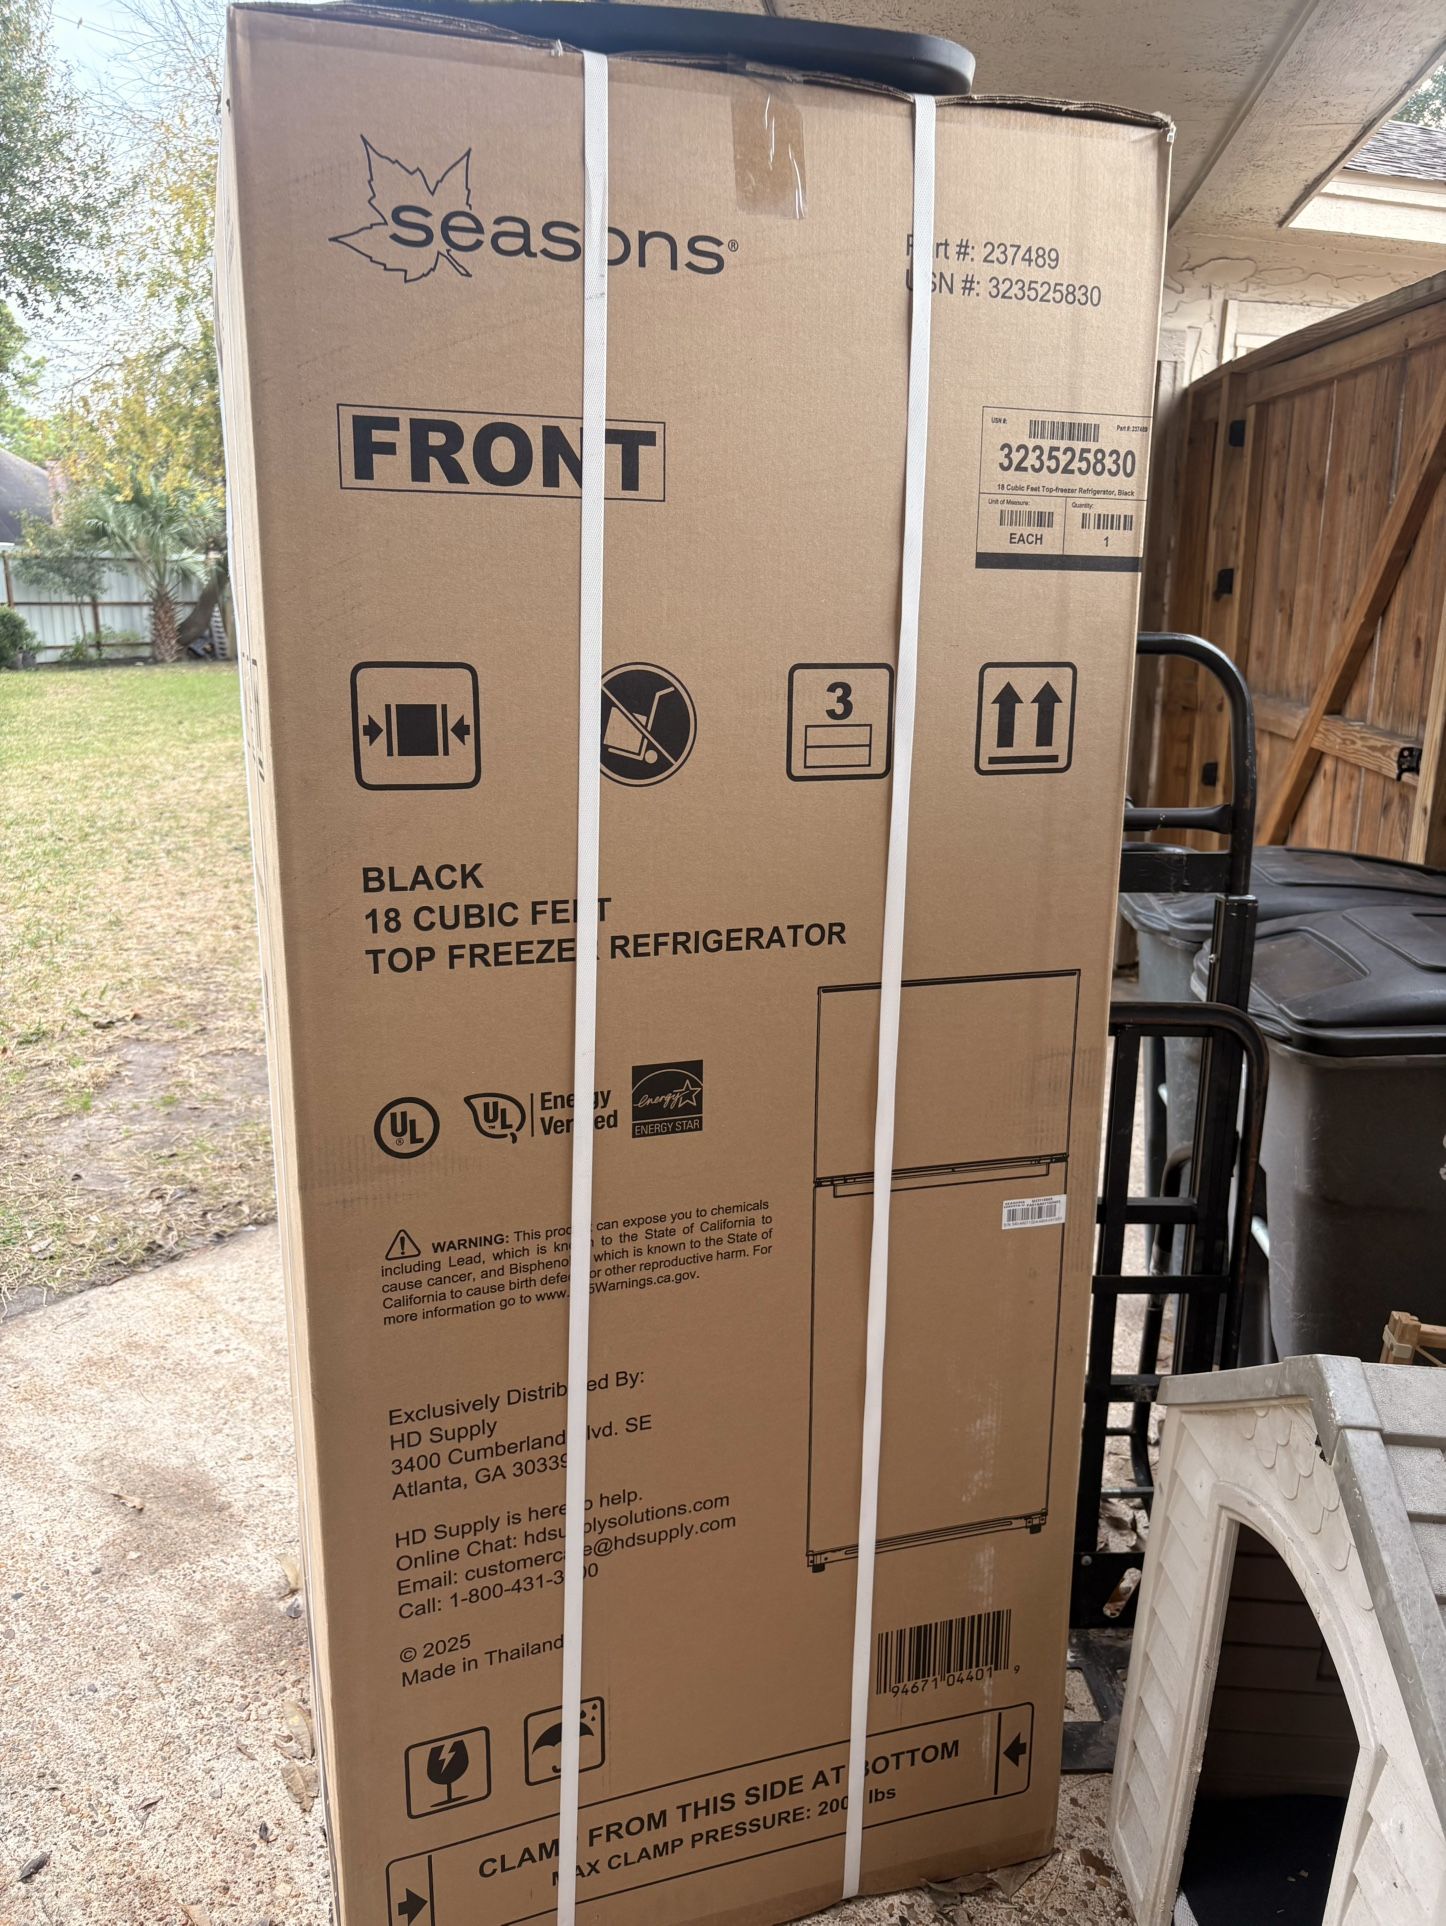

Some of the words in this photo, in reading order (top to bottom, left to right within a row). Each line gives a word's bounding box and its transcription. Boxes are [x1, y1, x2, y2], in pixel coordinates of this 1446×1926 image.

[956, 238, 975, 262] #:
[982, 241, 1060, 270] 237489
[961, 274, 980, 297] #:
[988, 276, 1101, 307] 323525830
[352, 415, 657, 491] FRONT
[999, 443, 1136, 478] 323525830
[1006, 484, 1025, 492] Cubic
[1042, 485, 1077, 494] Top-freezer
[1079, 487, 1117, 497] Refrigerator,
[1118, 489, 1135, 497] Black
[1009, 533, 1043, 545] EACH
[1103, 536, 1109, 547] 1
[826, 682, 853, 720] 3
[362, 863, 484, 893] BLACK
[365, 907, 402, 934] 18
[413, 901, 519, 932] CUBIC
[531, 898, 612, 926] FET
[365, 946, 436, 974] TOP
[448, 938, 599, 970] FREEZE
[610, 922, 846, 959] REFRIGERATOR
[483, 1101, 513, 1129] UL
[633, 1090, 686, 1110] energy
[390, 1111, 424, 1144] UL
[634, 1122, 674, 1136] ENERGY
[675, 1119, 700, 1132] STAR
[432, 1233, 510, 1253] WARNING:
[513, 1229, 541, 1243] This
[596, 1220, 619, 1231] can
[622, 1214, 667, 1230] expose
[670, 1211, 692, 1225] you
[696, 1207, 708, 1218] to
[710, 1200, 769, 1216] chemicals
[381, 1259, 442, 1277] including
[449, 1252, 486, 1268] Lead,
[492, 1246, 530, 1261] which
[536, 1243, 547, 1256] is
[601, 1236, 613, 1246] to
[619, 1231, 638, 1244] the
[645, 1227, 676, 1240] State
[682, 1223, 695, 1235] of
[700, 1217, 756, 1233] California
[761, 1215, 773, 1225] to
[382, 1279, 423, 1293] cause
[427, 1273, 476, 1288] cancer,
[480, 1266, 505, 1279] and
[593, 1246, 629, 1262] which
[633, 1244, 643, 1257] is
[647, 1240, 686, 1255] known
[690, 1238, 701, 1249] to
[705, 1234, 723, 1247] the
[727, 1231, 757, 1244] State
[761, 1227, 774, 1240] of
[383, 1289, 447, 1309] California
[450, 1288, 463, 1299] to
[466, 1283, 505, 1297] cause
[508, 1276, 537, 1291] birth
[589, 1267, 602, 1279] or
[604, 1263, 636, 1277] other
[639, 1252, 713, 1273] reproductive
[716, 1248, 750, 1261] harm.
[753, 1243, 773, 1256] For
[383, 1312, 418, 1325] more
[422, 1301, 496, 1320] information
[500, 1298, 515, 1311] go
[520, 1293, 532, 1305] to
[389, 1394, 501, 1426] Exclusively
[507, 1373, 609, 1406] Distribed
[615, 1370, 645, 1390] By:
[390, 1431, 422, 1450] HD
[429, 1419, 498, 1444] Supply
[391, 1452, 441, 1475] 3400
[448, 1430, 566, 1465] Cumberland
[586, 1421, 618, 1441] lvd.
[625, 1415, 652, 1433] SE
[392, 1475, 469, 1500] Atlanta,
[475, 1465, 507, 1484] GA
[395, 1528, 427, 1548] HD
[434, 1515, 500, 1540] Supply
[506, 1511, 522, 1526] is
[528, 1503, 567, 1522] here
[600, 1489, 643, 1508] help.
[396, 1549, 460, 1571] Online
[467, 1535, 517, 1557] Chat:
[398, 1570, 458, 1596] Email:
[399, 1597, 442, 1619] Call:
[402, 1664, 456, 1687] Made
[463, 1657, 478, 1672] in
[484, 1634, 564, 1666] Thailand
[423, 1634, 471, 1659] 2025
[892, 1677, 938, 1698] 94671
[946, 1665, 993, 1687] 04401
[1013, 1665, 1021, 1674] 9
[479, 1836, 578, 1878] CLAM
[588, 1809, 667, 1847] FROM
[676, 1792, 736, 1823] THIS
[745, 1775, 804, 1806] SIDE
[812, 1765, 846, 1790] AT
[607, 1837, 684, 1870] CLAMP
[691, 1805, 811, 1848] PRESSURE:
[869, 1788, 896, 1804] lbs
